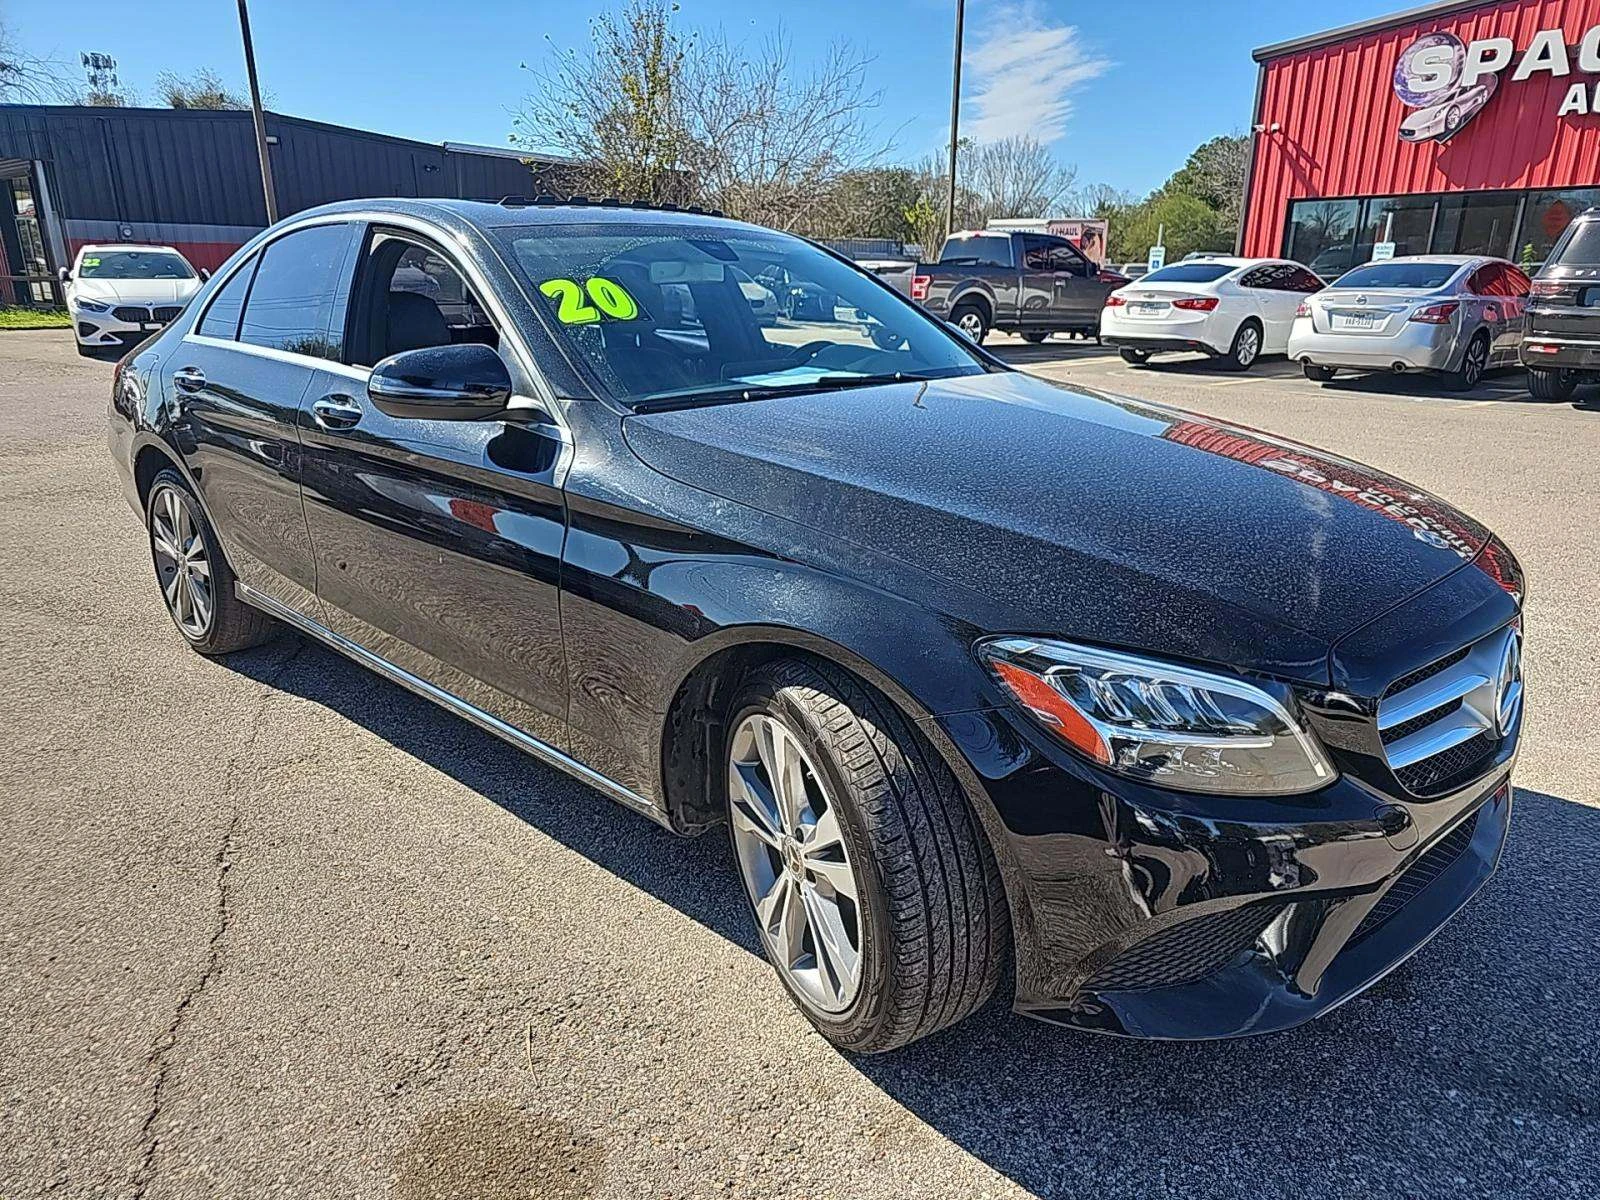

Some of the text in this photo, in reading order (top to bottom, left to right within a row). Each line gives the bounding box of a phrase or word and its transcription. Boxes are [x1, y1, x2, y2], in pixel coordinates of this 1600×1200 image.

[1556, 82, 1600, 116] A
[83, 258, 101, 267] 22
[539, 276, 639, 325] 20
